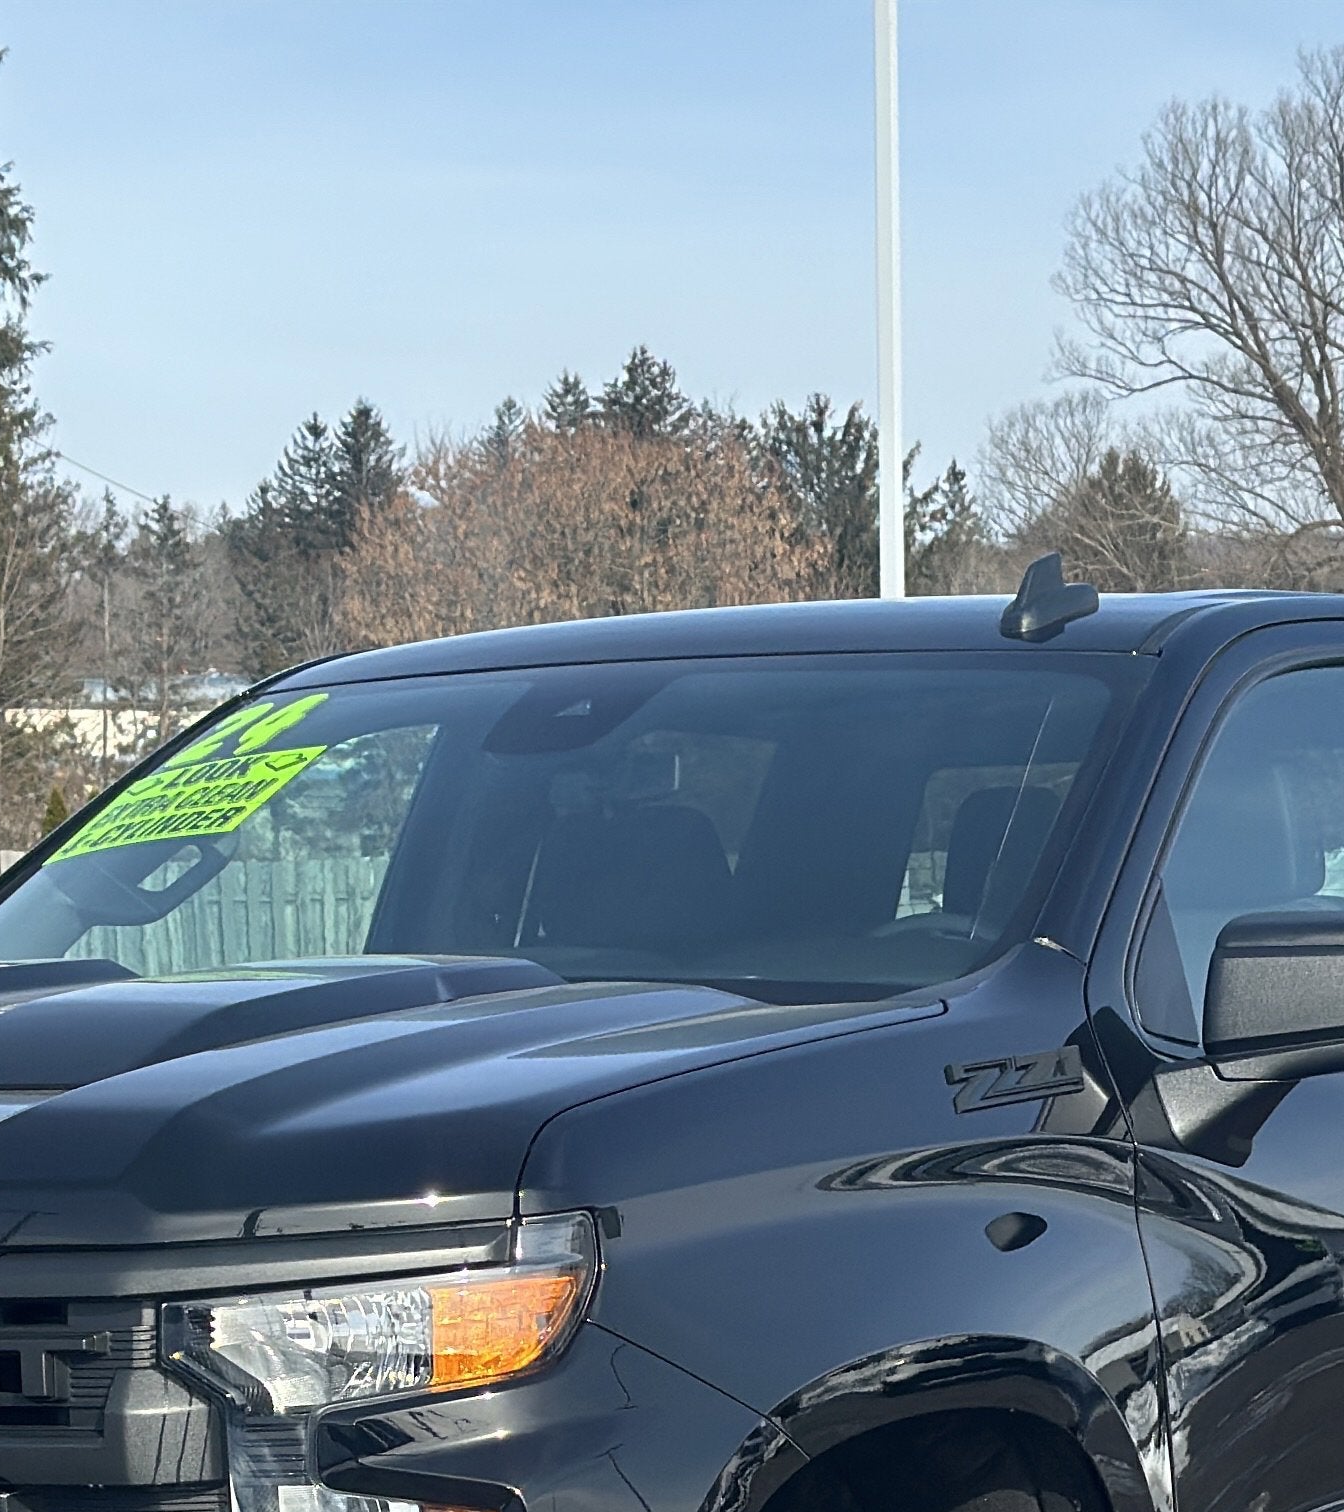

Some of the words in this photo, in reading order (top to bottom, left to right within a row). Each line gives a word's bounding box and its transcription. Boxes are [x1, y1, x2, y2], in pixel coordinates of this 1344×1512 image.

[166, 694, 329, 768] 24
[162, 754, 266, 792] LOOK
[174, 777, 278, 812] CLEAN
